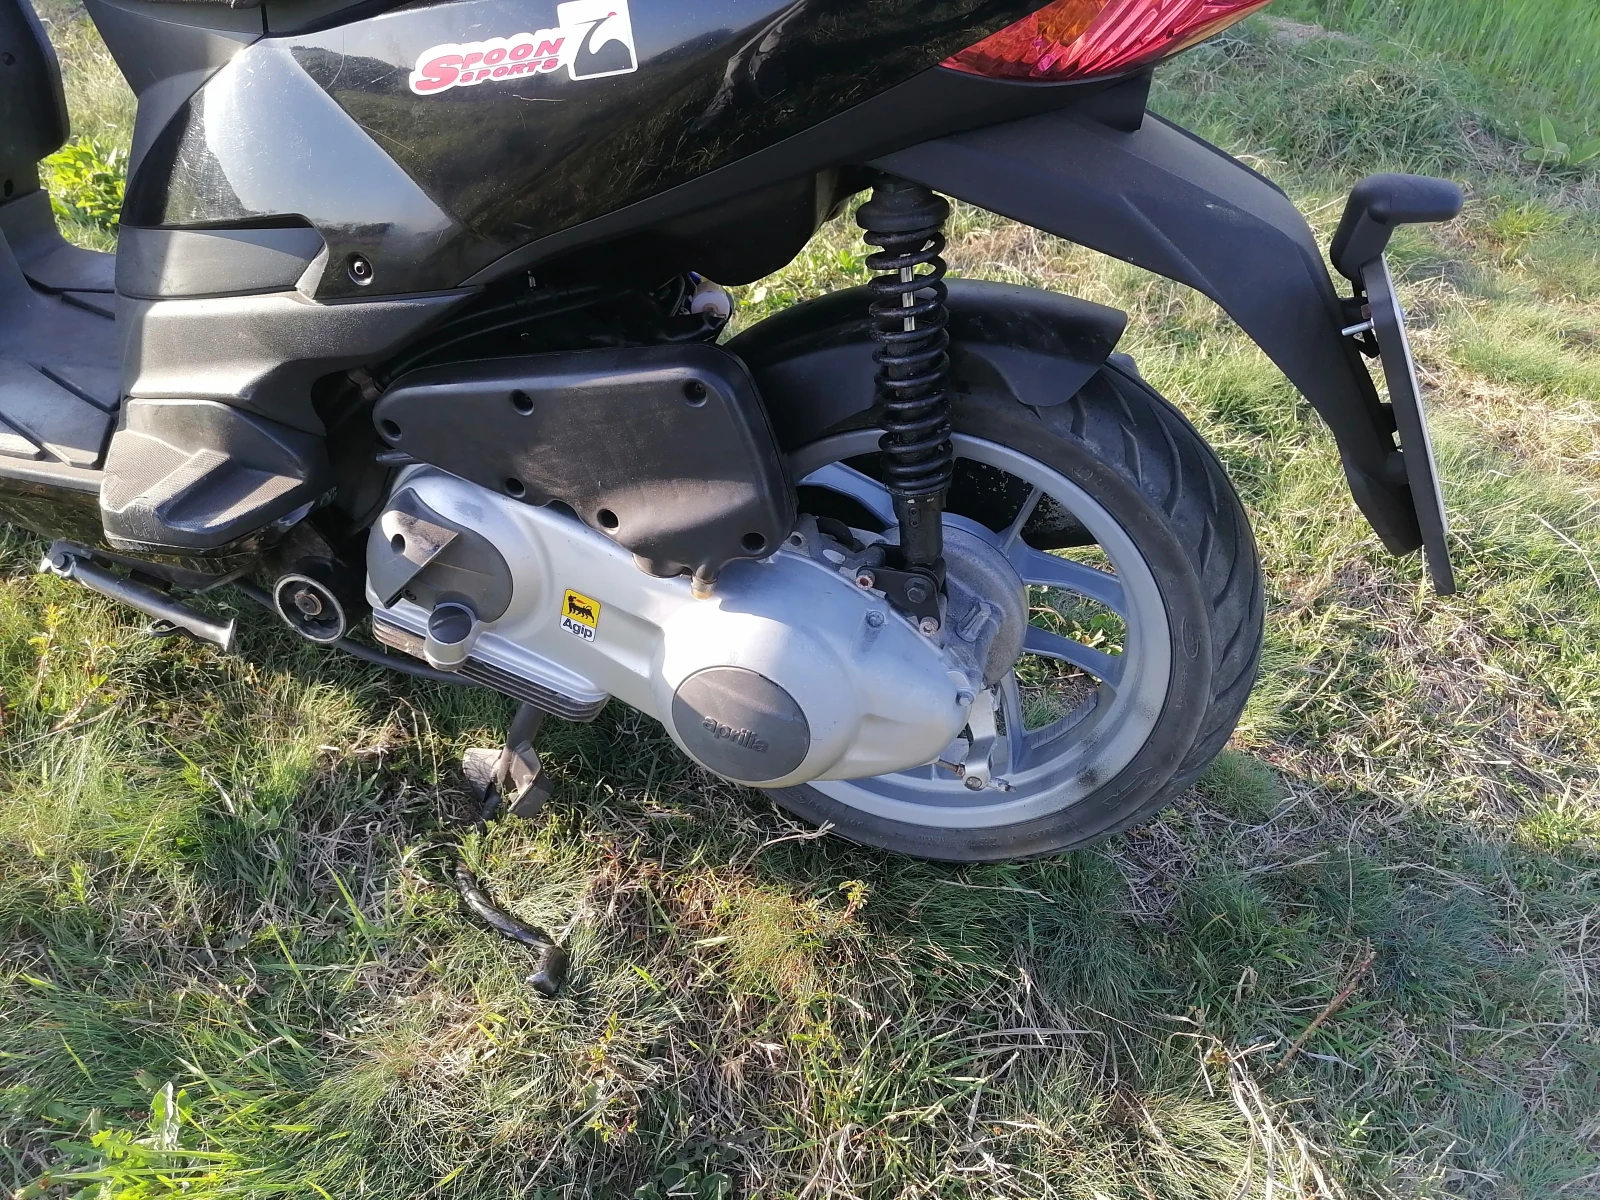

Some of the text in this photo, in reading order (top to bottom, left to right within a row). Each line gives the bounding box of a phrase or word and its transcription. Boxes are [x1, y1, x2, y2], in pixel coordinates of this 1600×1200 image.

[415, 37, 565, 90] SPOON
[460, 58, 559, 83] SPORTS
[563, 618, 593, 638] Agip
[702, 716, 768, 754] aprilia
